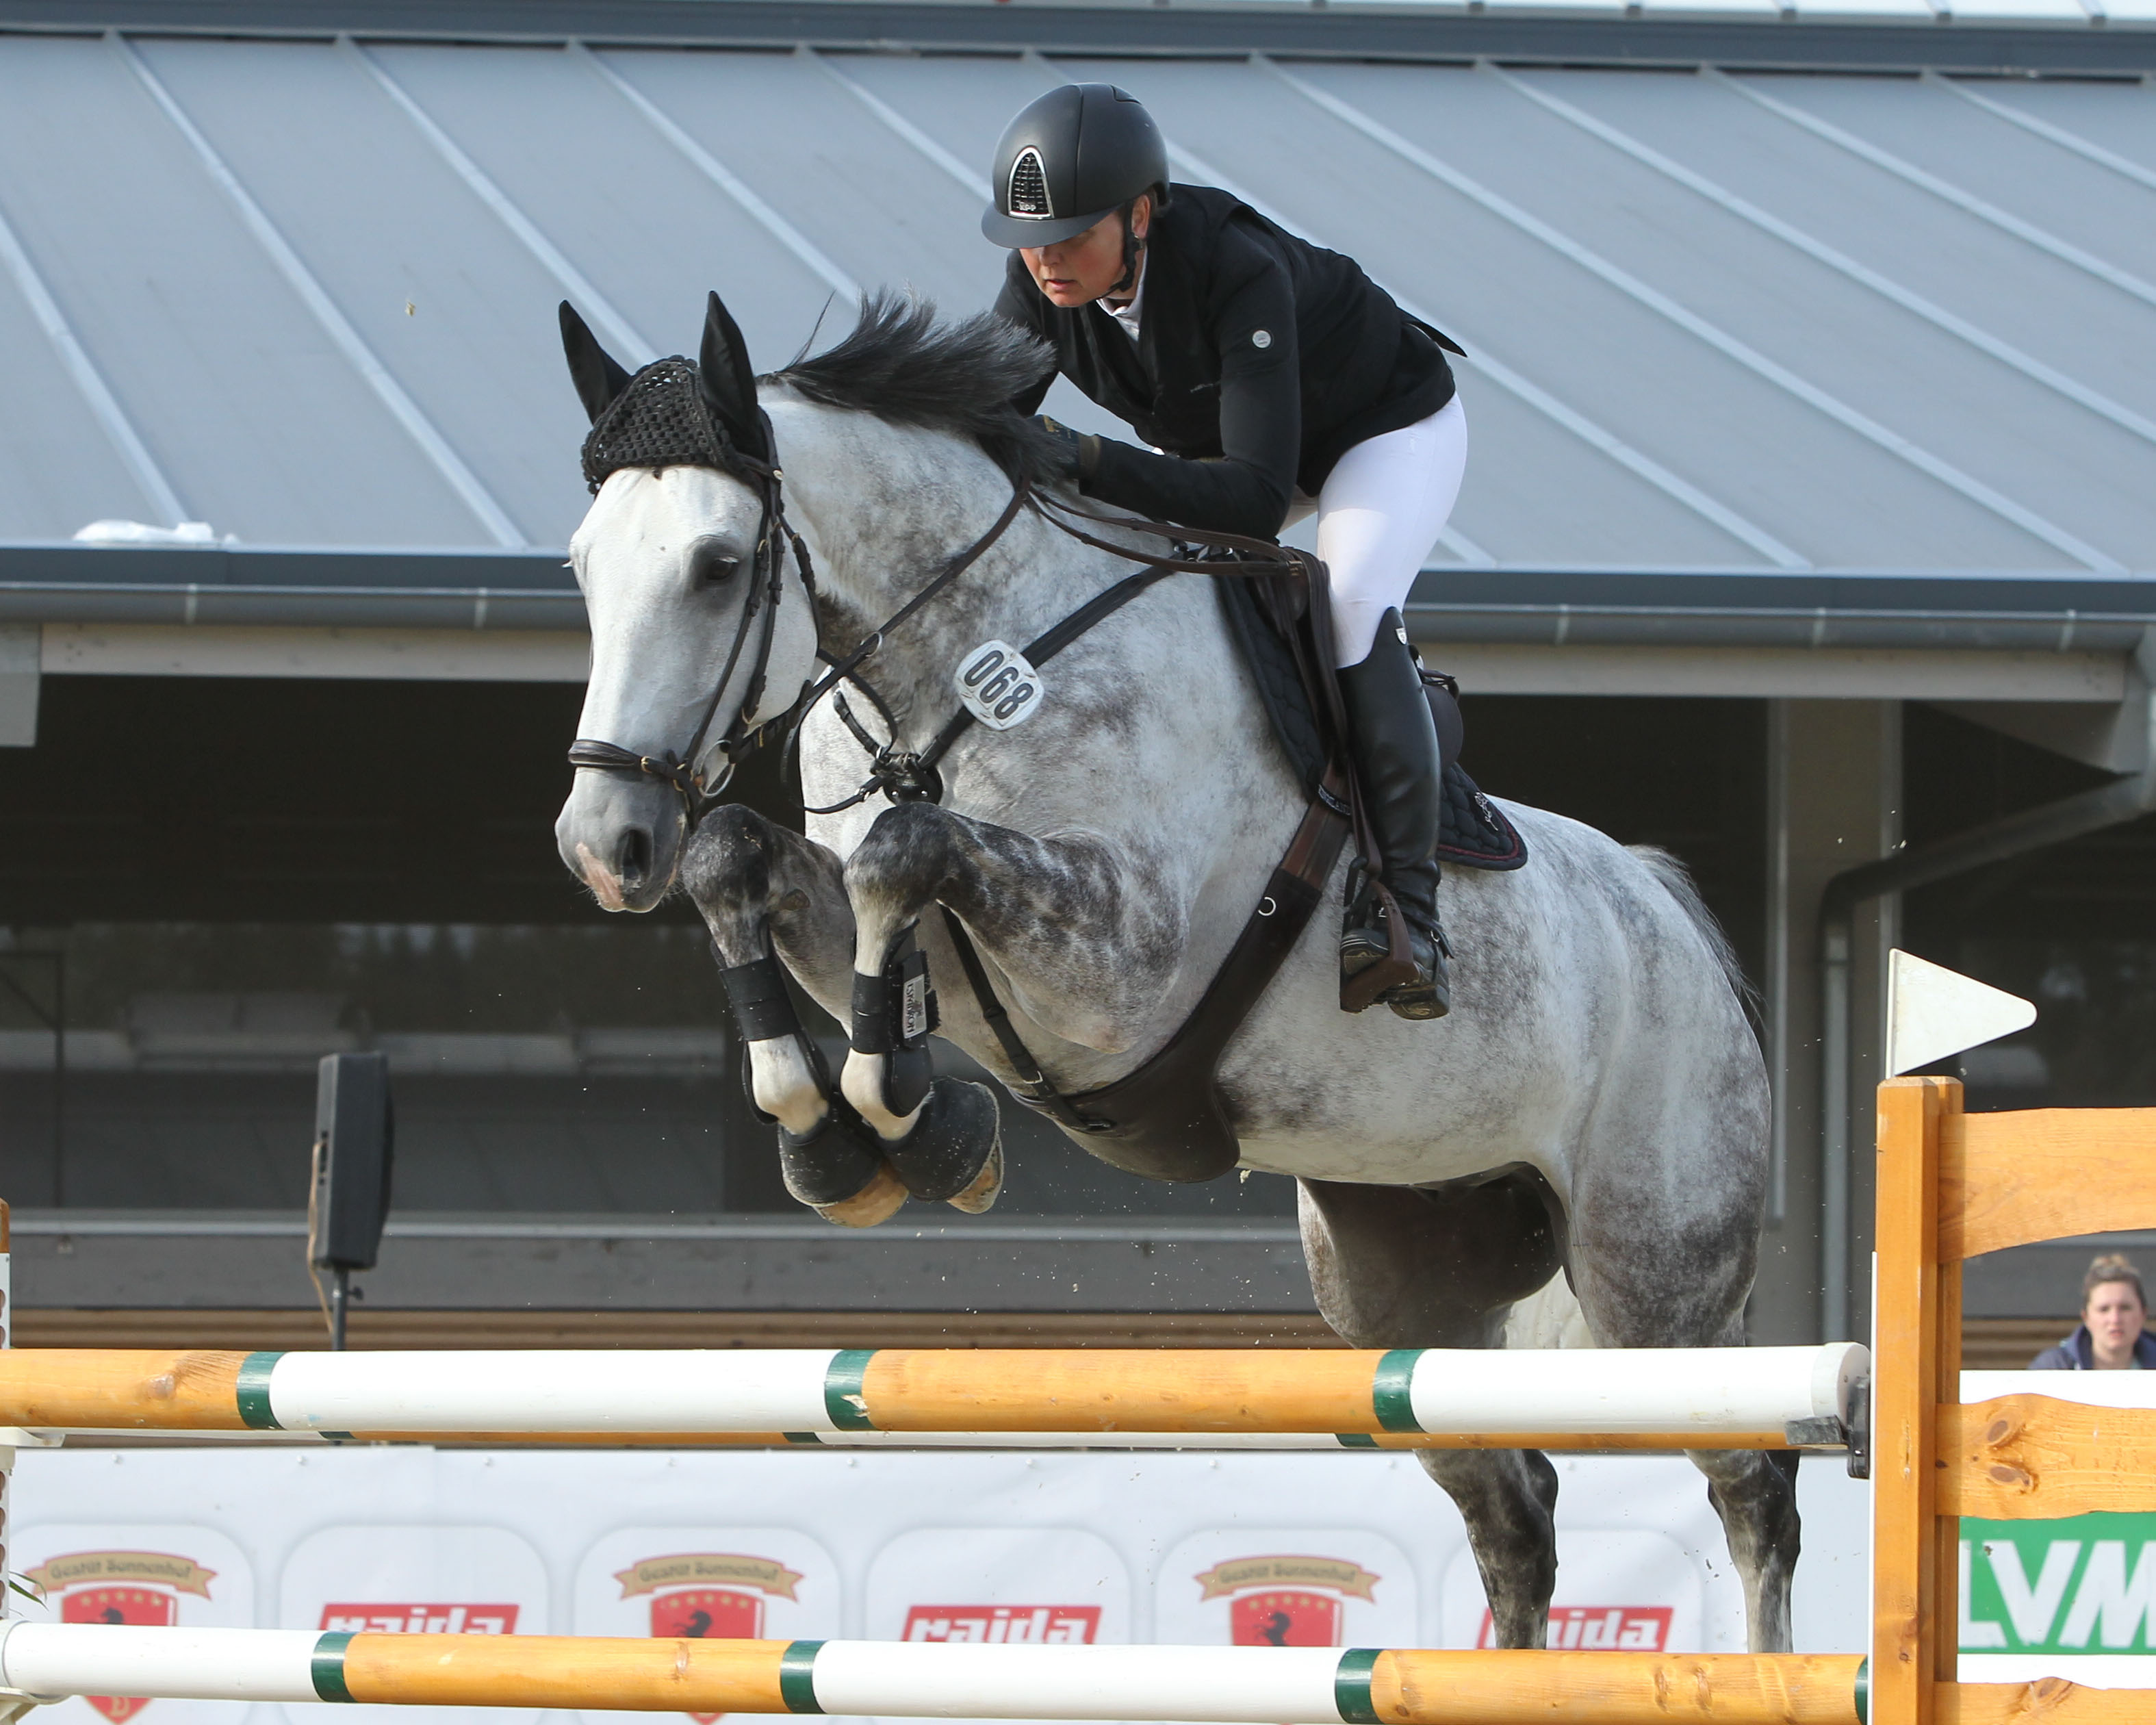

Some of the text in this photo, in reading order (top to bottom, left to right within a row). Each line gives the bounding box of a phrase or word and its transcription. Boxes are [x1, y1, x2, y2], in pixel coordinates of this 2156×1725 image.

[964, 650, 1034, 720] 068
[908, 1609, 1088, 1644] raida
[1958, 1539, 2156, 1649] LVM
